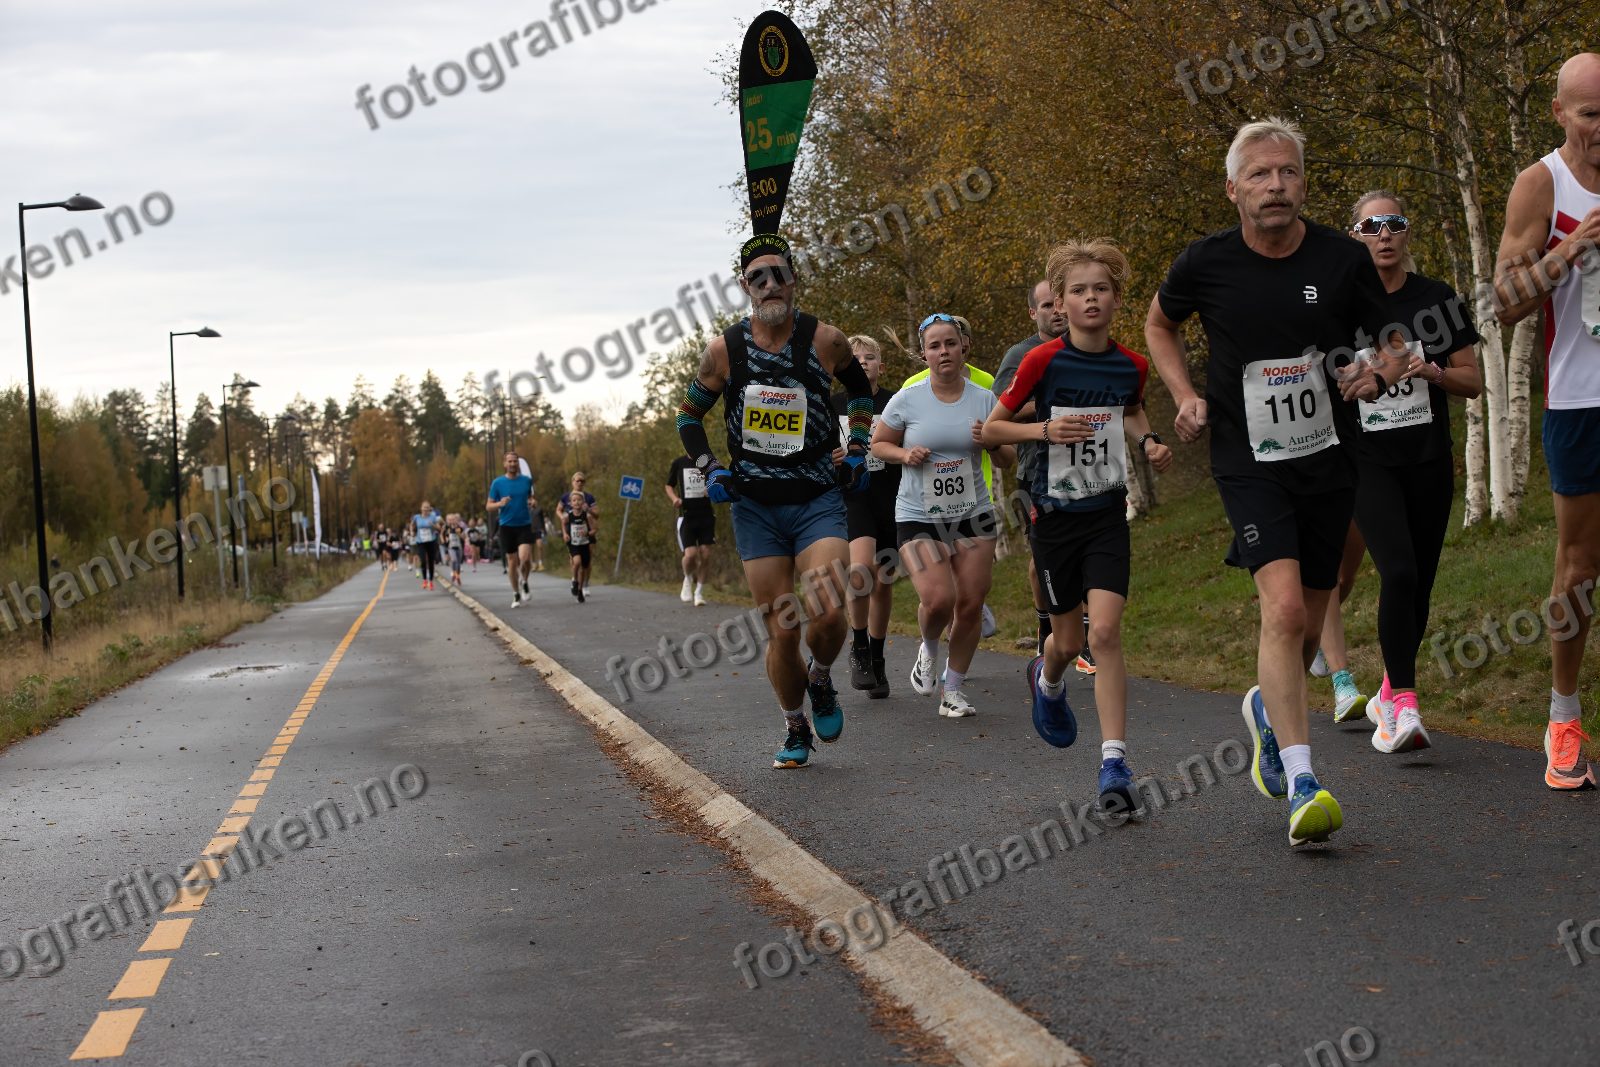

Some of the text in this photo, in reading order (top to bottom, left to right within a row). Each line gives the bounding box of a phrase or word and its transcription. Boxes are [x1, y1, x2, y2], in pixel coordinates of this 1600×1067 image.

[747, 117, 798, 152] 25 min
[1261, 361, 1313, 377] NORGES
[1267, 373, 1308, 386] LØPET
[759, 390, 798, 400] NORGES
[762, 398, 790, 406] LØPET
[1264, 388, 1317, 424] 110
[1390, 405, 1429, 418] Aurskog
[749, 410, 800, 431] PACE
[1288, 425, 1333, 447] Aurskog
[765, 441, 801, 451] Aurskog
[1066, 439, 1108, 467] 151
[937, 466, 958, 474] LØPET
[933, 476, 965, 496] 963
[946, 501, 976, 511] Aurskog
